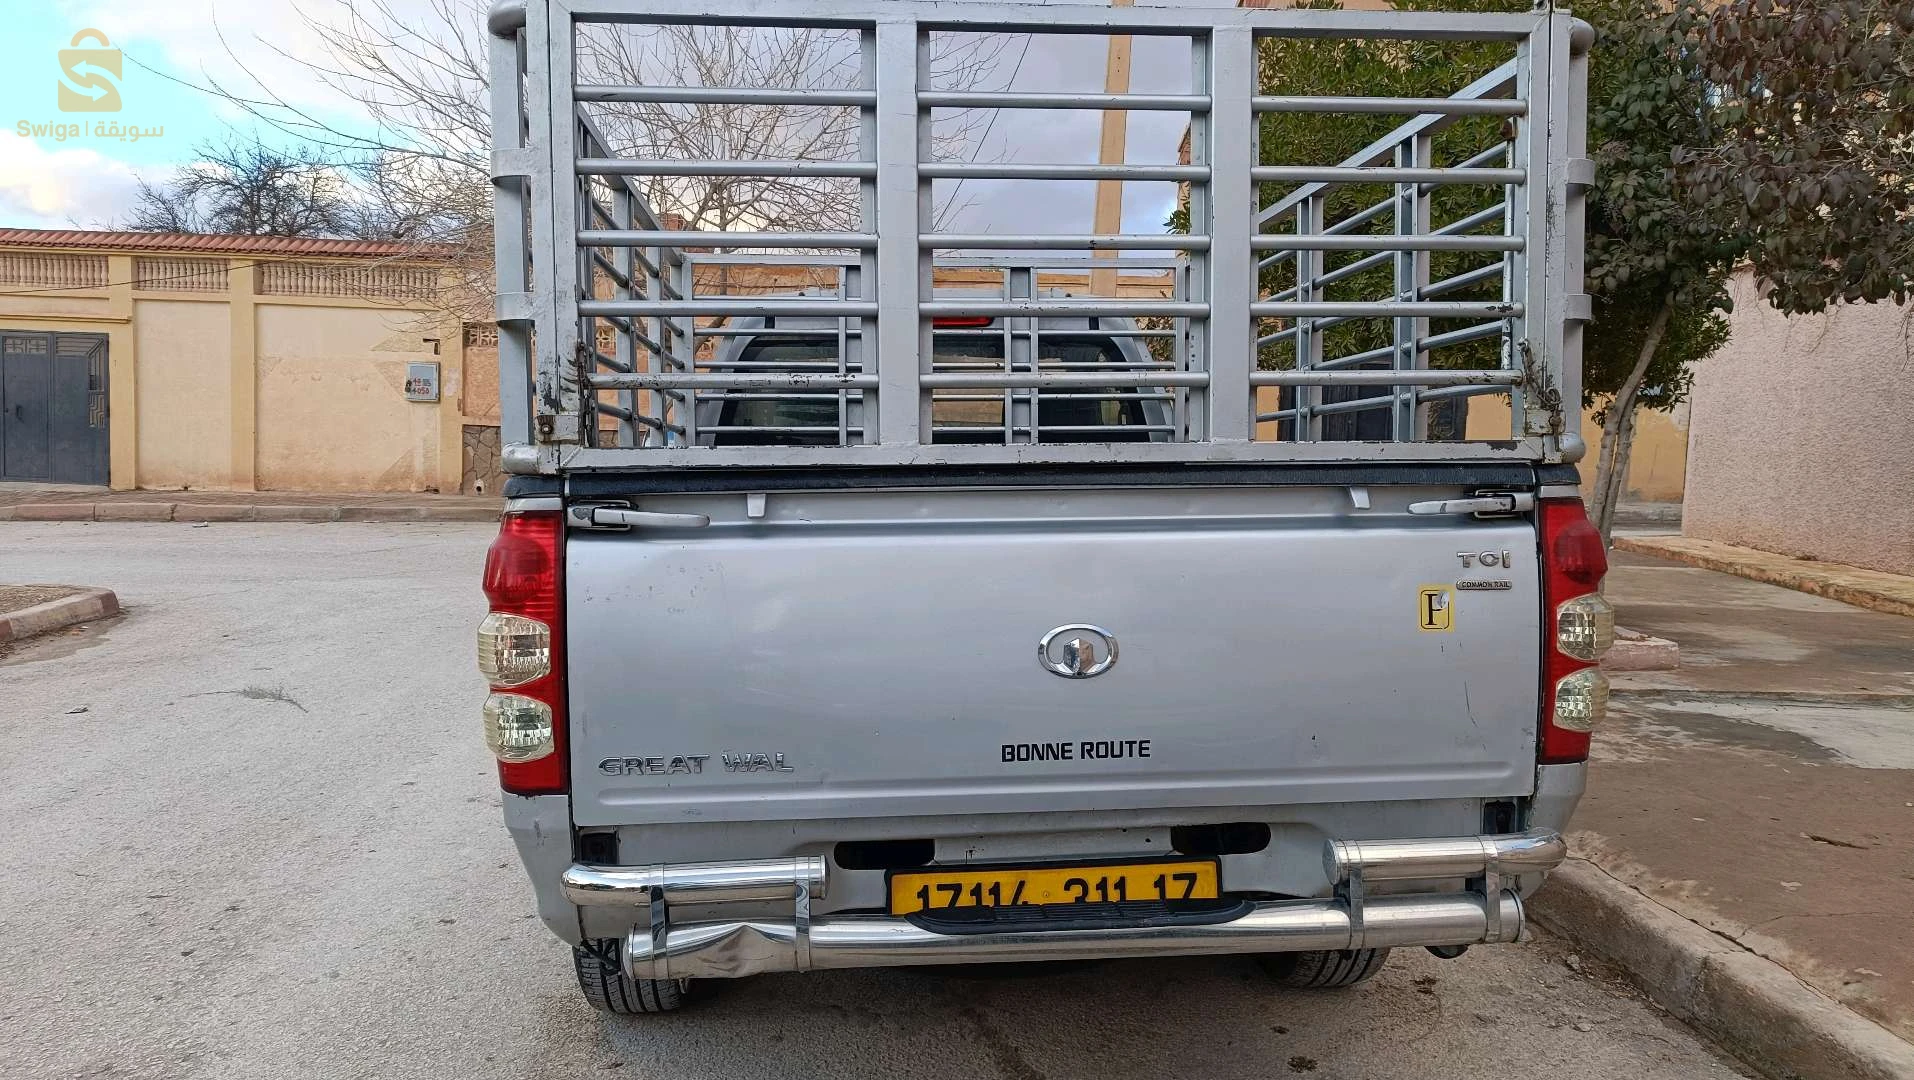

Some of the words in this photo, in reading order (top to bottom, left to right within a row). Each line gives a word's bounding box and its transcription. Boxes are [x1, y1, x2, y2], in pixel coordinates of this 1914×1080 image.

[1456, 549, 1511, 569] TCI
[1461, 581, 1493, 589] COMMON
[1494, 581, 1510, 589] RAIL
[1001, 742, 1073, 763] BONNE
[1080, 739, 1151, 760] ROUTE
[598, 754, 710, 777] GREAT
[720, 751, 794, 774] WAL
[1153, 872, 1198, 900] 17
